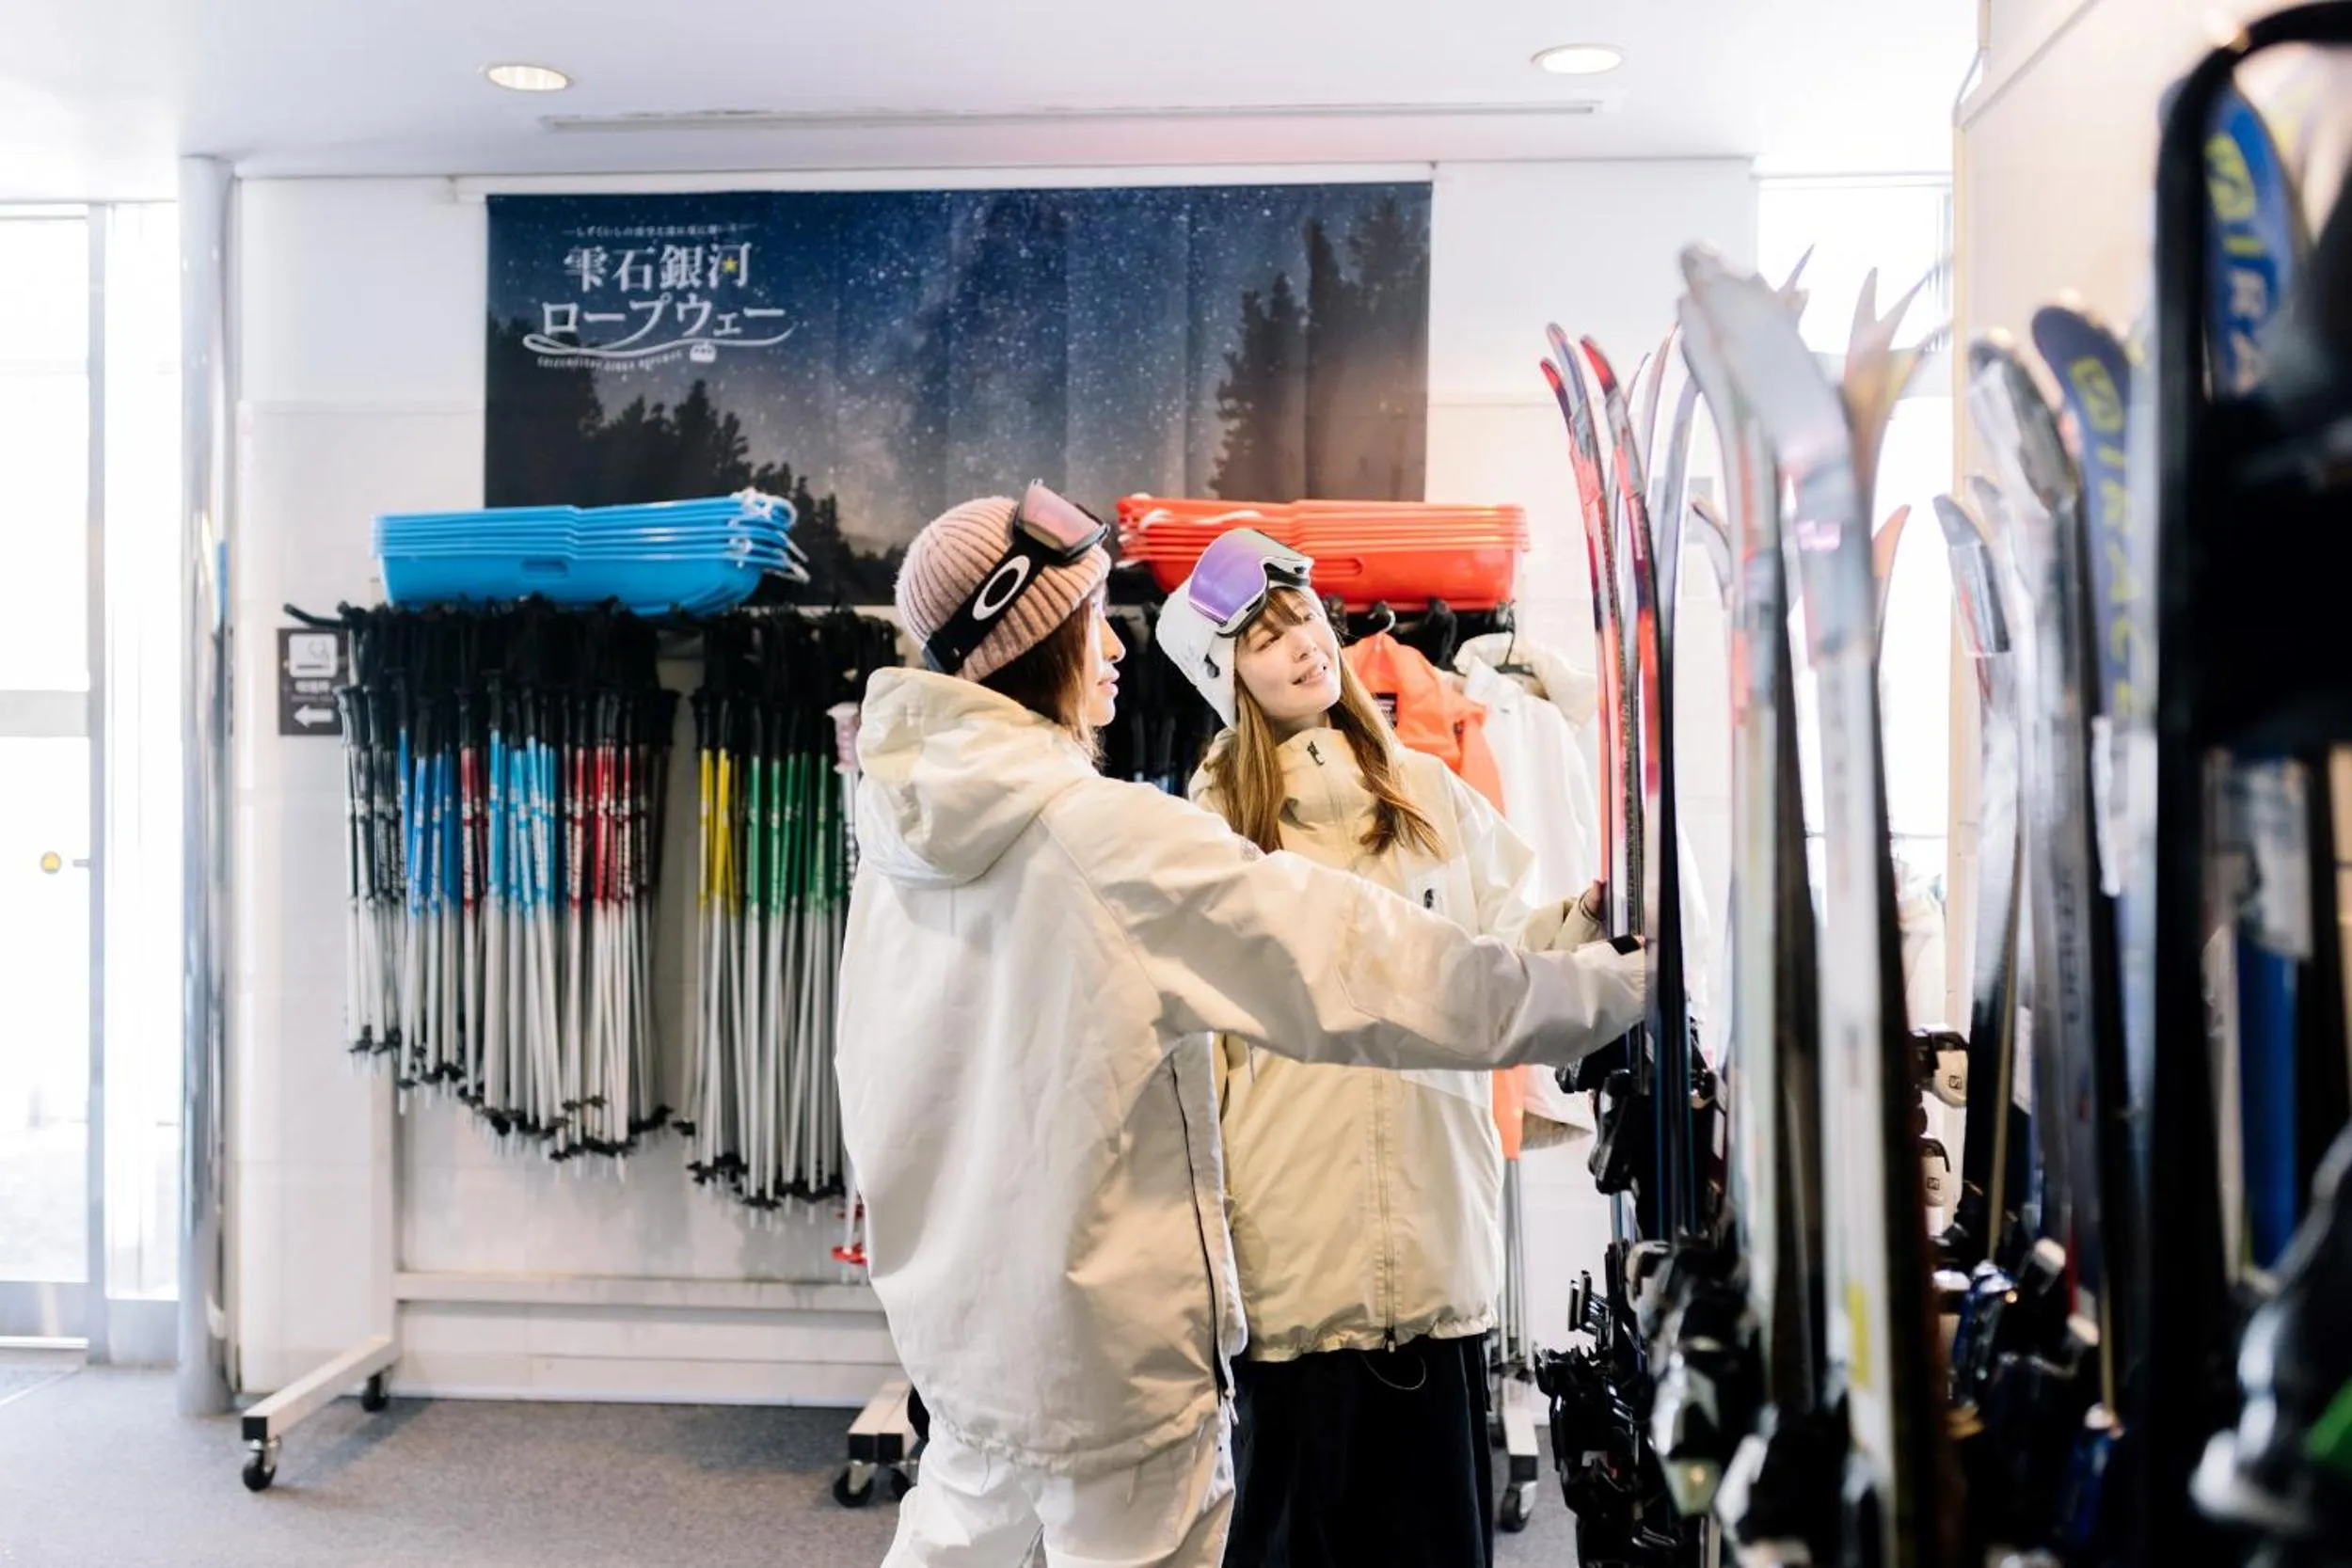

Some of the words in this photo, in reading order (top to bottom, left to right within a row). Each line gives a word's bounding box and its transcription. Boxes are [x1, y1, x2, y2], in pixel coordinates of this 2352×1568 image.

[564, 242, 752, 293] 雫石銀河
[542, 293, 787, 337] ロープウェー
